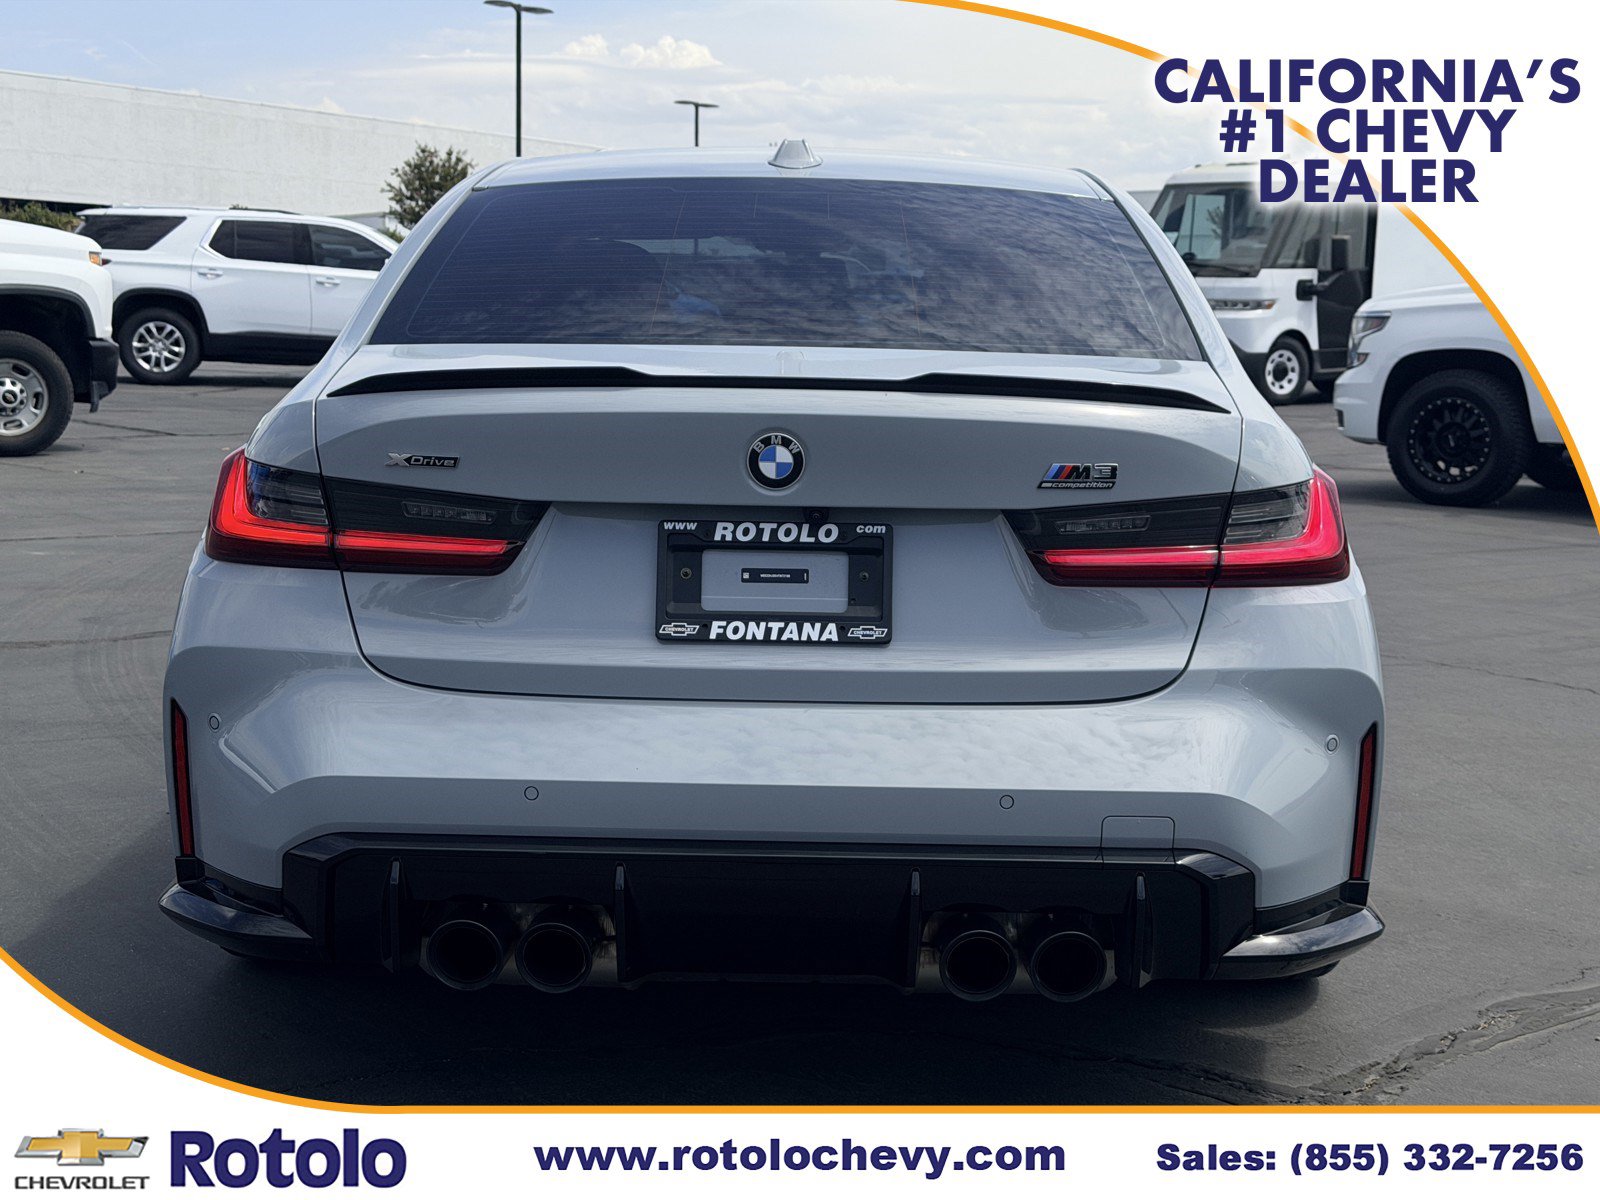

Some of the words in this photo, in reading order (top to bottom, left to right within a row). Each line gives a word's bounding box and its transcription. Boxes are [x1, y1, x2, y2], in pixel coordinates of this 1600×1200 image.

[753, 436, 800, 453] BMW
[1042, 463, 1118, 480] M3
[1051, 481, 1113, 489] competition
[714, 523, 838, 543] ROTOLO
[709, 621, 838, 641] FONTANA
